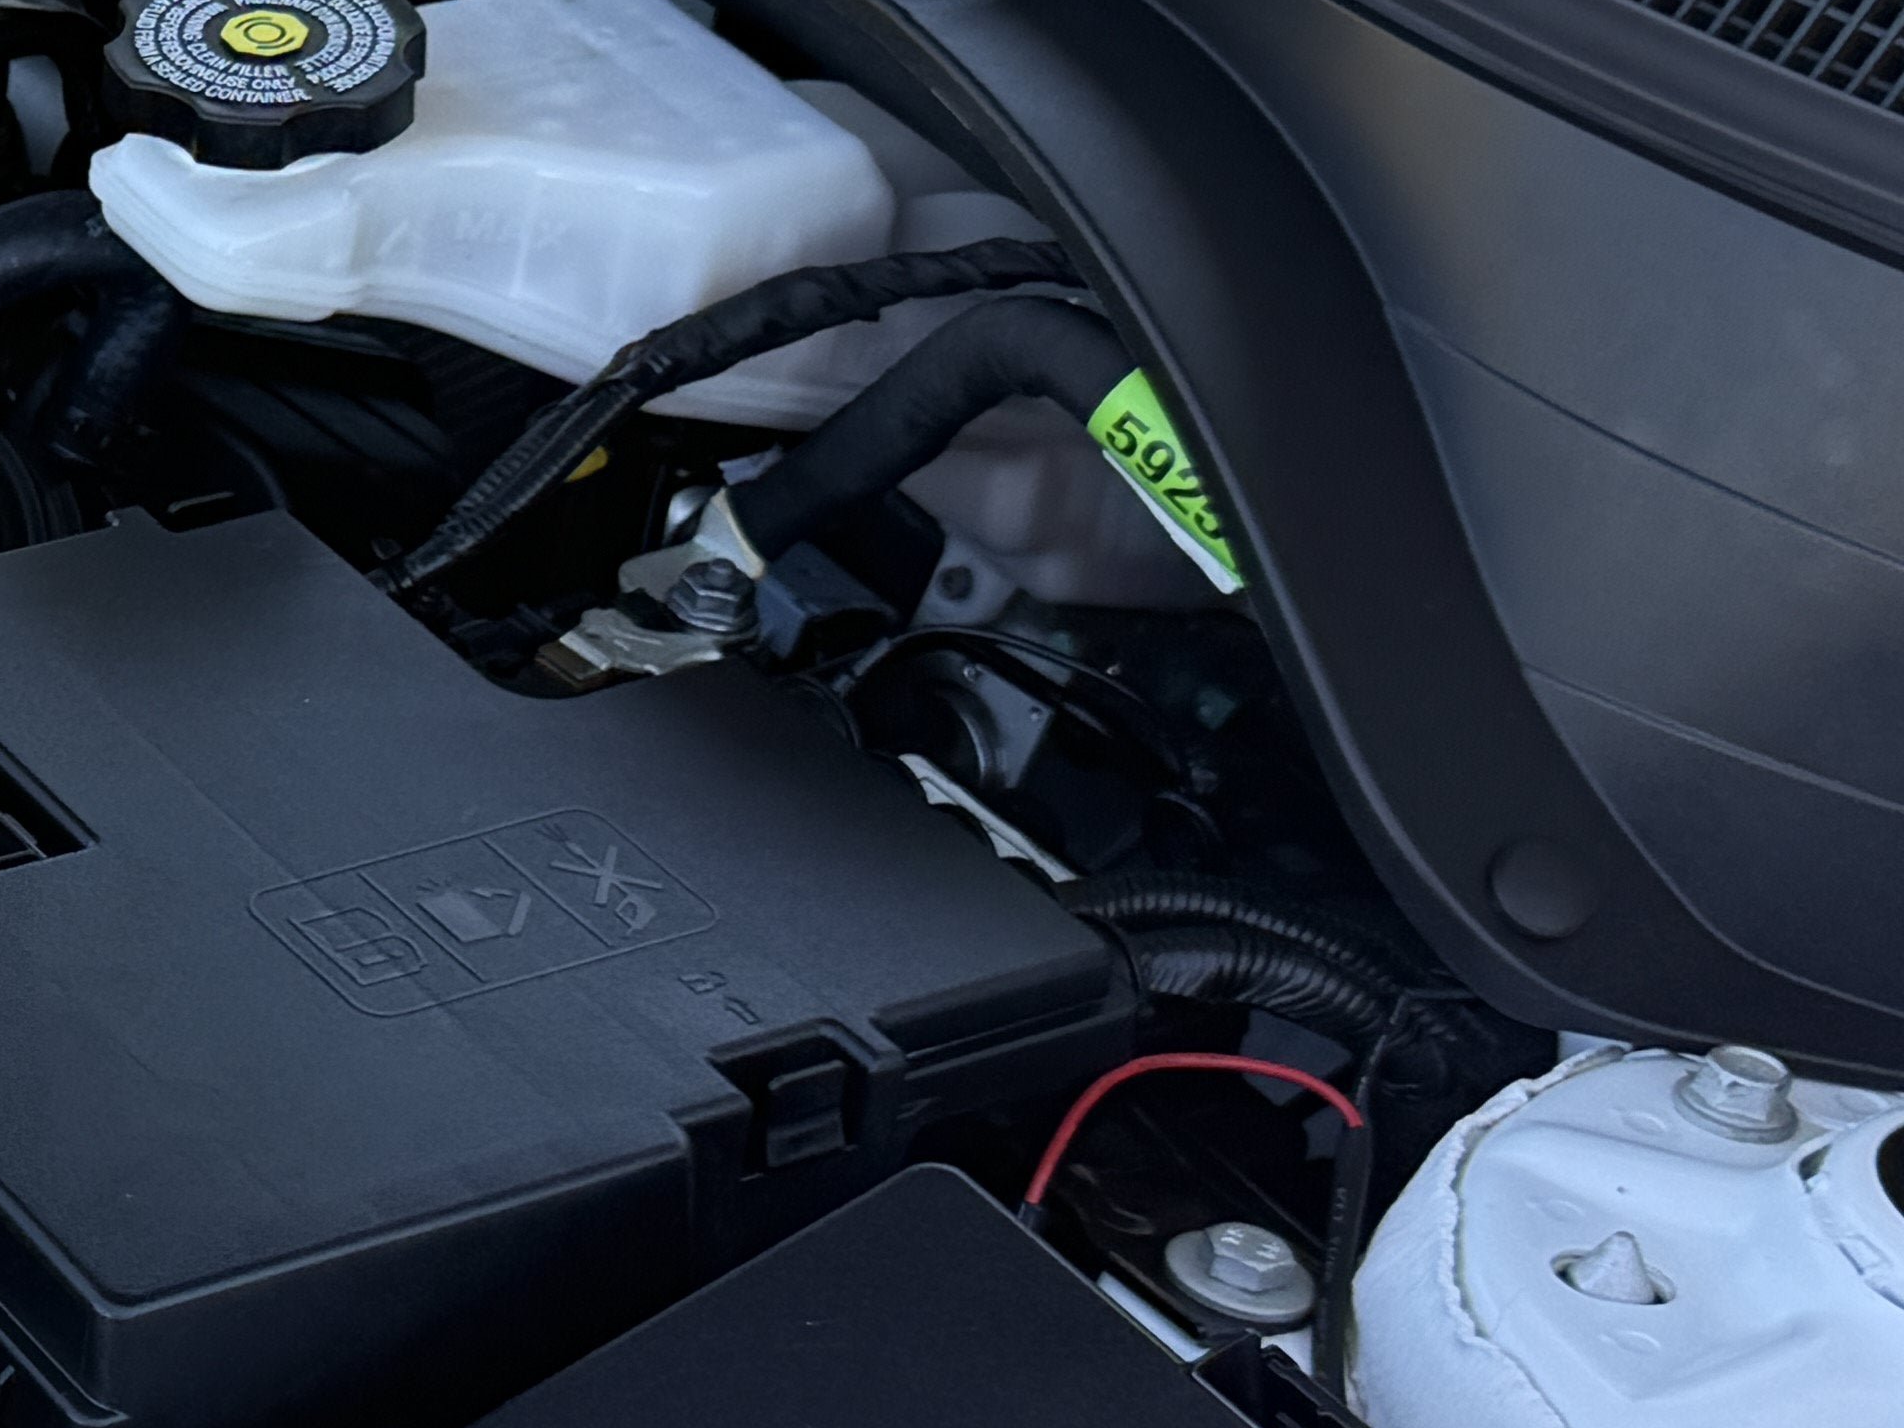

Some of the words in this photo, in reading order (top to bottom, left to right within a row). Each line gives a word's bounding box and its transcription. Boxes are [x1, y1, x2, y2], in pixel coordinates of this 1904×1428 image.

[187, 43, 231, 70] CLEAN
[228, 62, 289, 78] FILLER
[150, 61, 207, 92] SEALED
[215, 73, 250, 89] USE
[252, 76, 295, 90] ONLY
